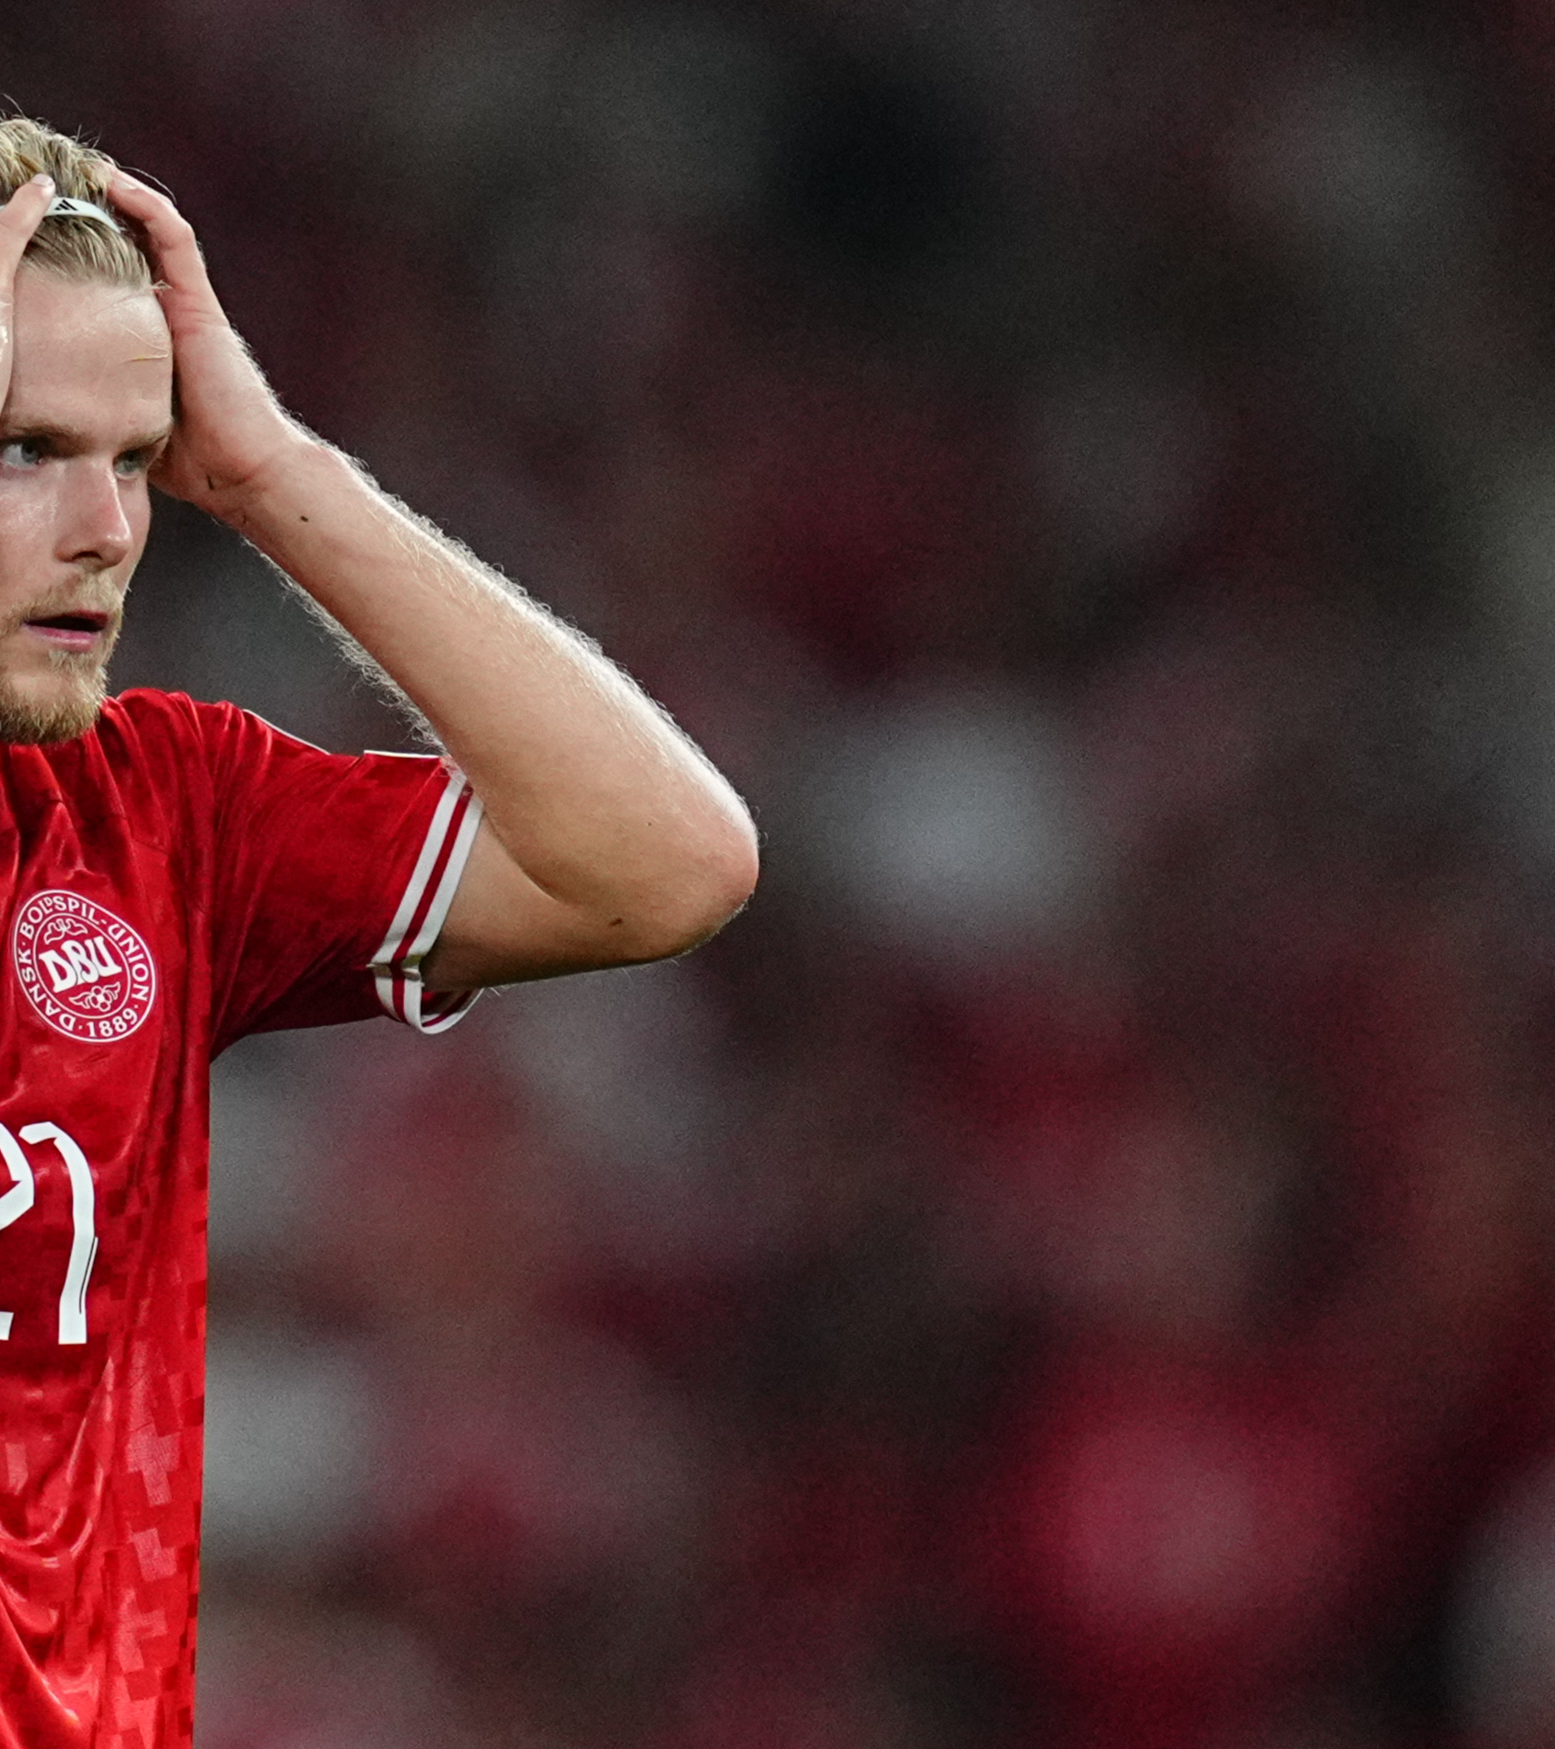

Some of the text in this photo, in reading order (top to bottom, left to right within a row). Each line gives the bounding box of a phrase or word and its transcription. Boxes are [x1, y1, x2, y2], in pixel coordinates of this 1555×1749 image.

[18, 948, 77, 1032] DANSK
[86, 1008, 138, 1037] 1889
[38, 935, 123, 993] DBU
